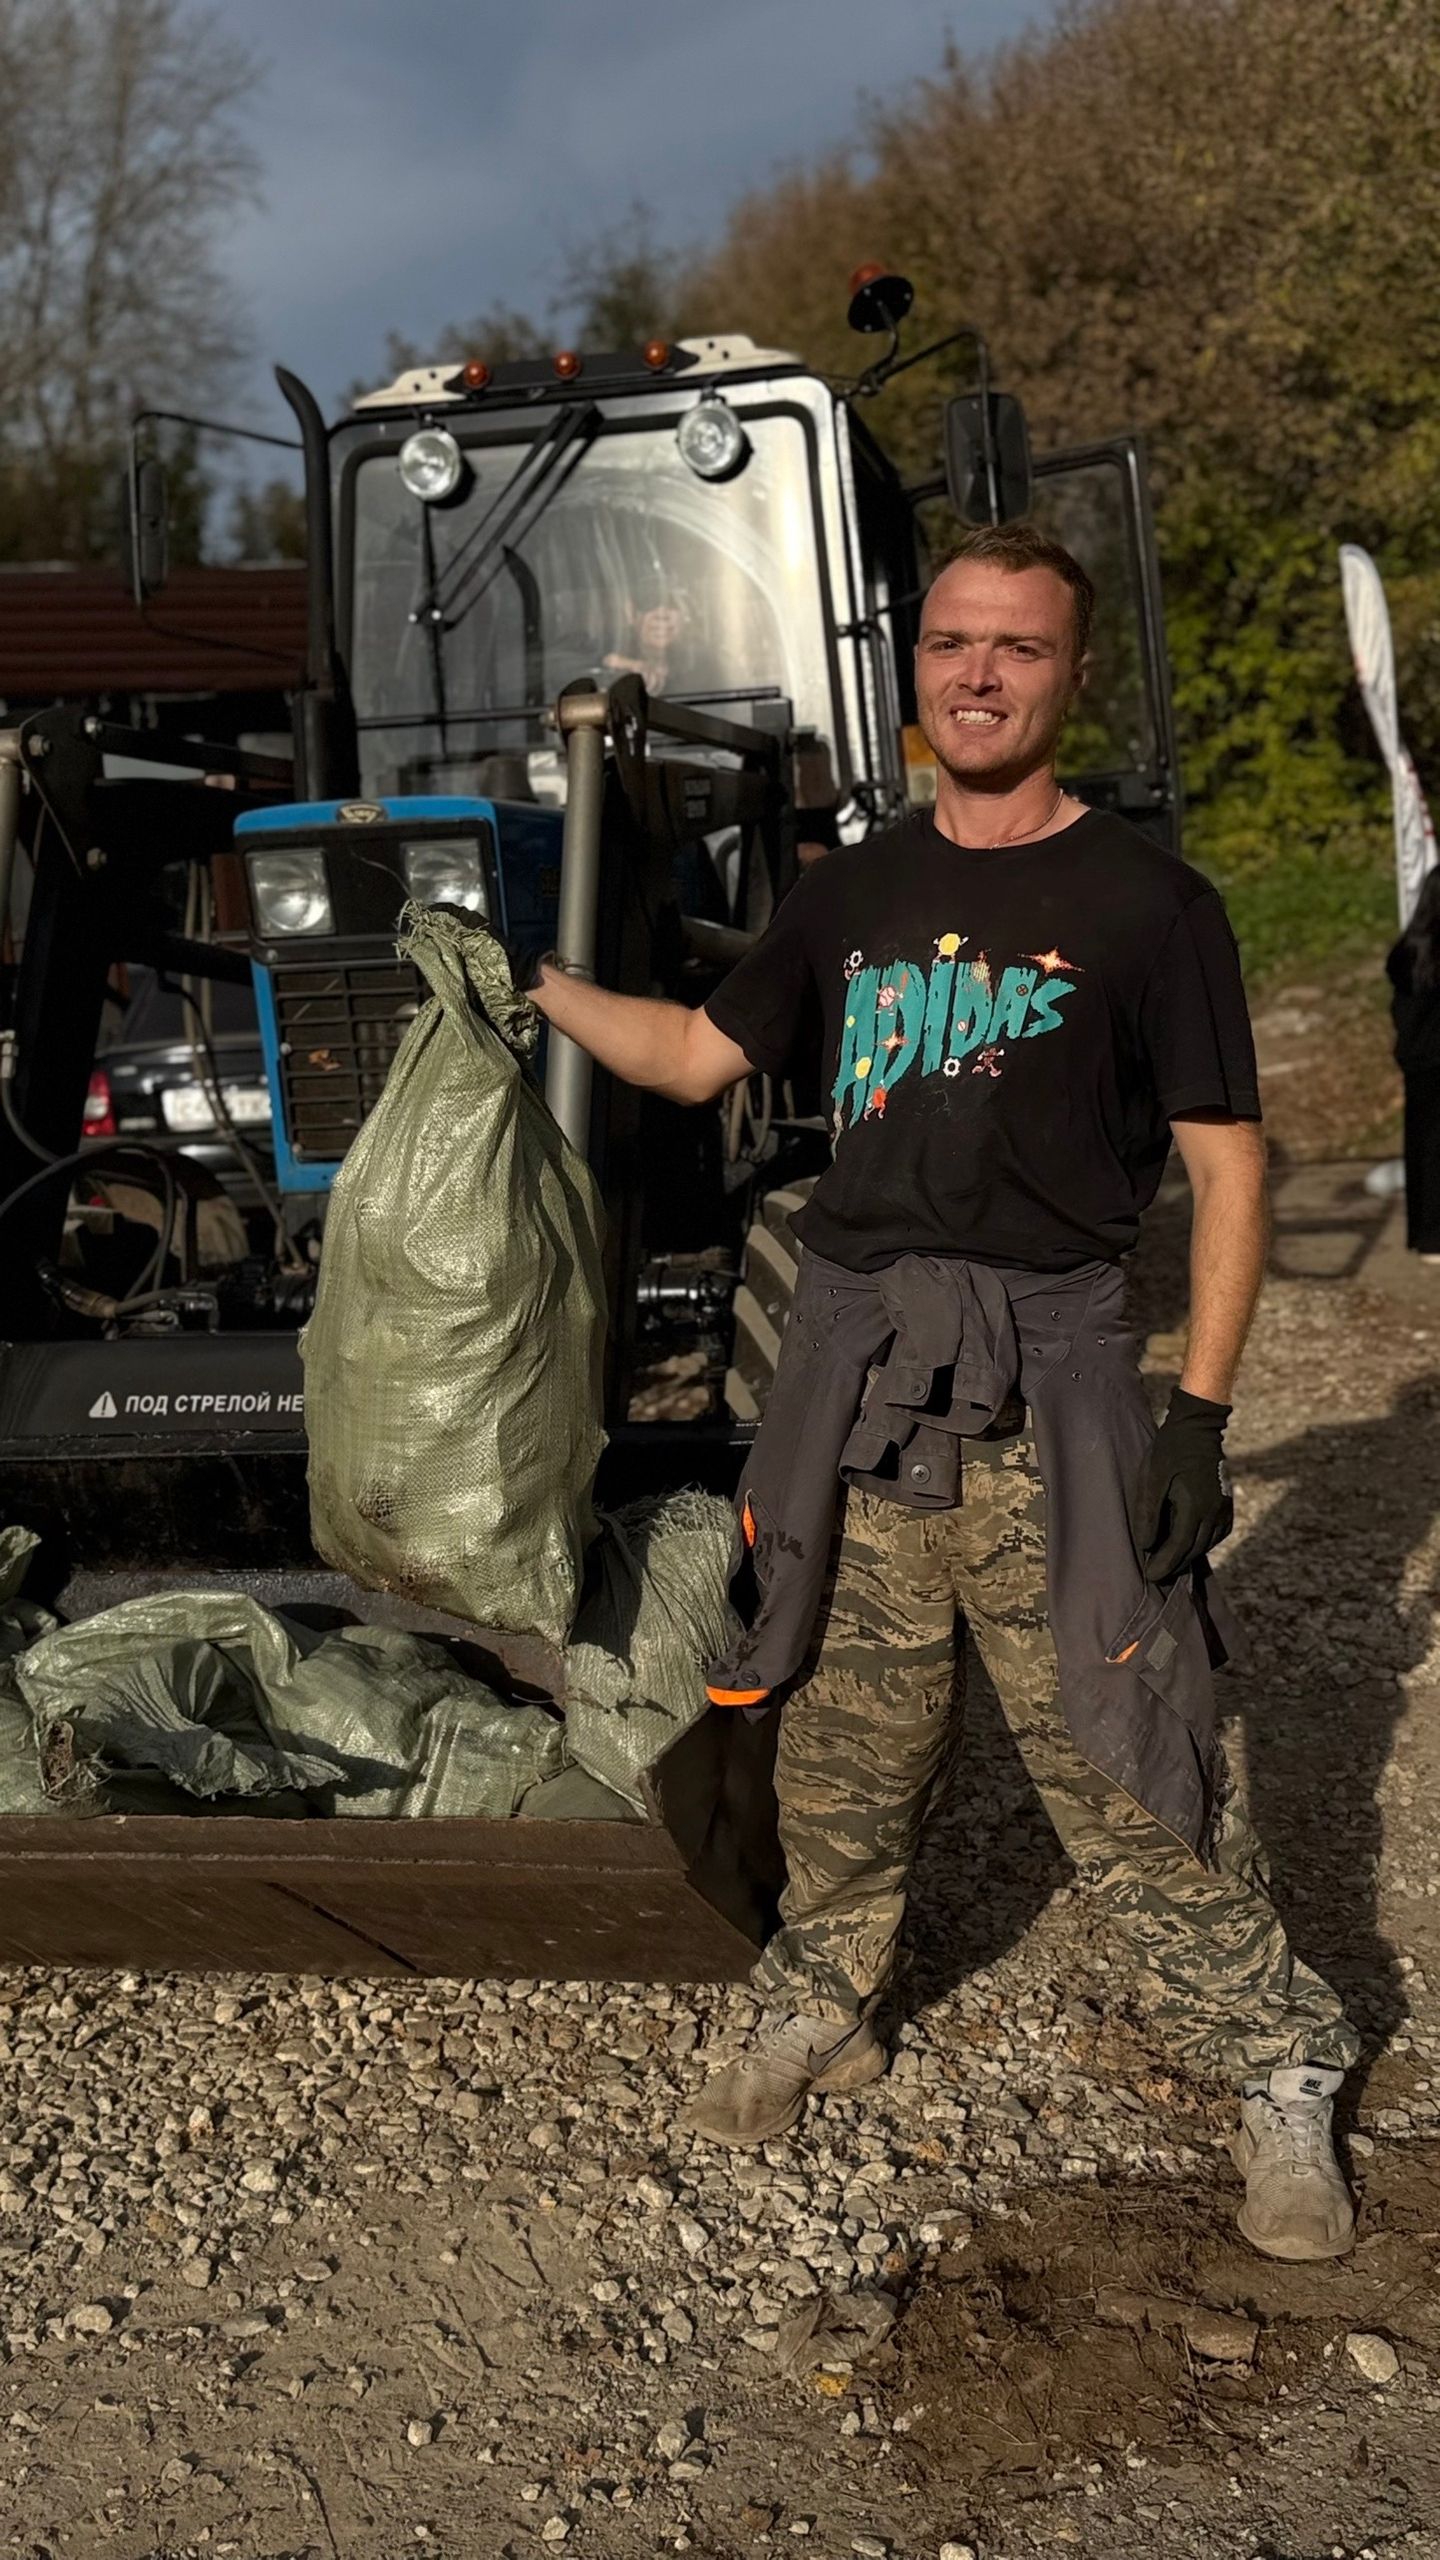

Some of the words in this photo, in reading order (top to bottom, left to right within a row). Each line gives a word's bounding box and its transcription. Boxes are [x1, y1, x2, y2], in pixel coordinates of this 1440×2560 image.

[831, 959, 1077, 1130] ADIDAS
[125, 1395, 168, 1415] ПОД
[174, 1391, 272, 1412] СТРЕЛОЙ
[276, 1395, 304, 1412] НЕ
